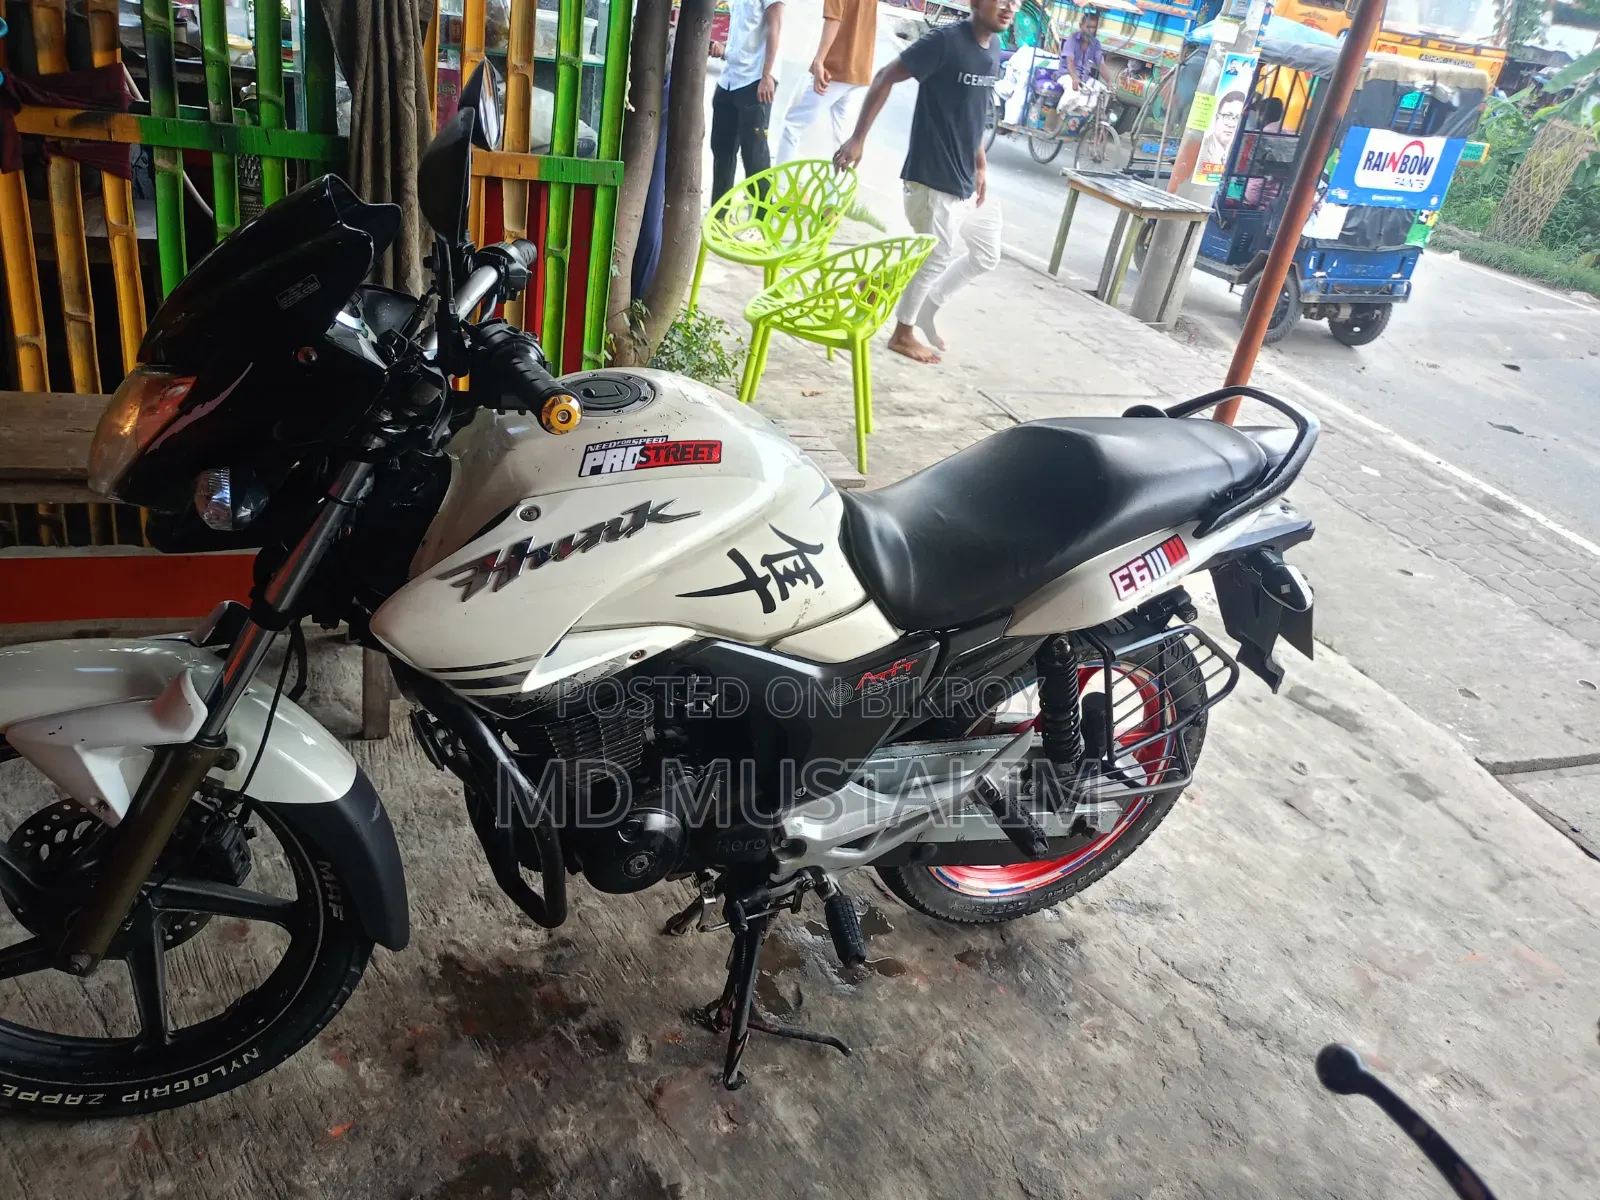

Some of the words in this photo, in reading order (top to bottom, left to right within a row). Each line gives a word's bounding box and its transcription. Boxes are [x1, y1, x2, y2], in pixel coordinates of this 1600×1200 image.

[1363, 147, 1434, 176] RAINBOW
[587, 441, 616, 453] NEED
[632, 436, 667, 445] SPEED
[436, 498, 703, 602] Hunk
[121, 1048, 260, 1103] NYLOGRIP
